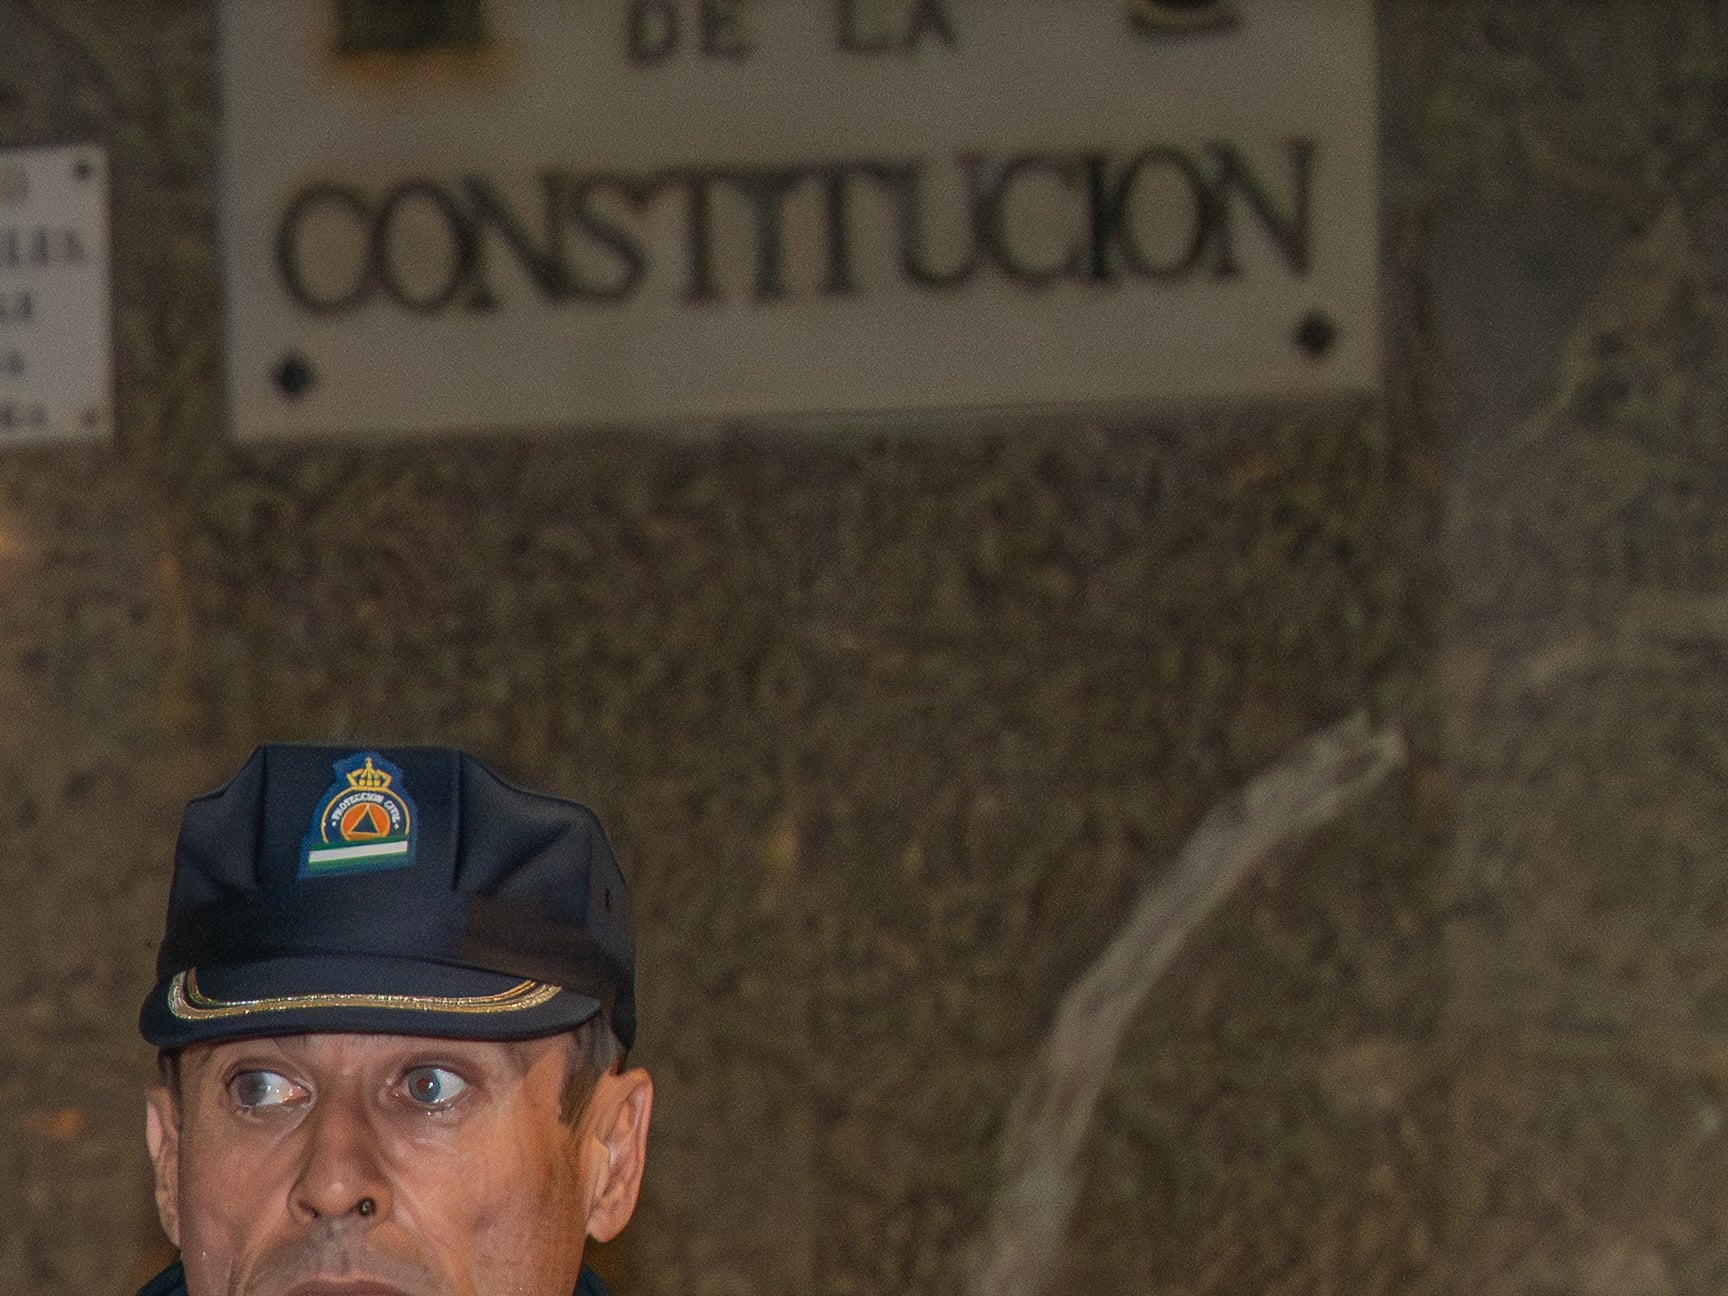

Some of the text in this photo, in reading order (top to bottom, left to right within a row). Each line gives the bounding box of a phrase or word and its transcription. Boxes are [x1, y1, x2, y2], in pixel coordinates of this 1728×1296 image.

[627, 0, 958, 67] DE LA
[275, 138, 1318, 315] CONSTITUCION
